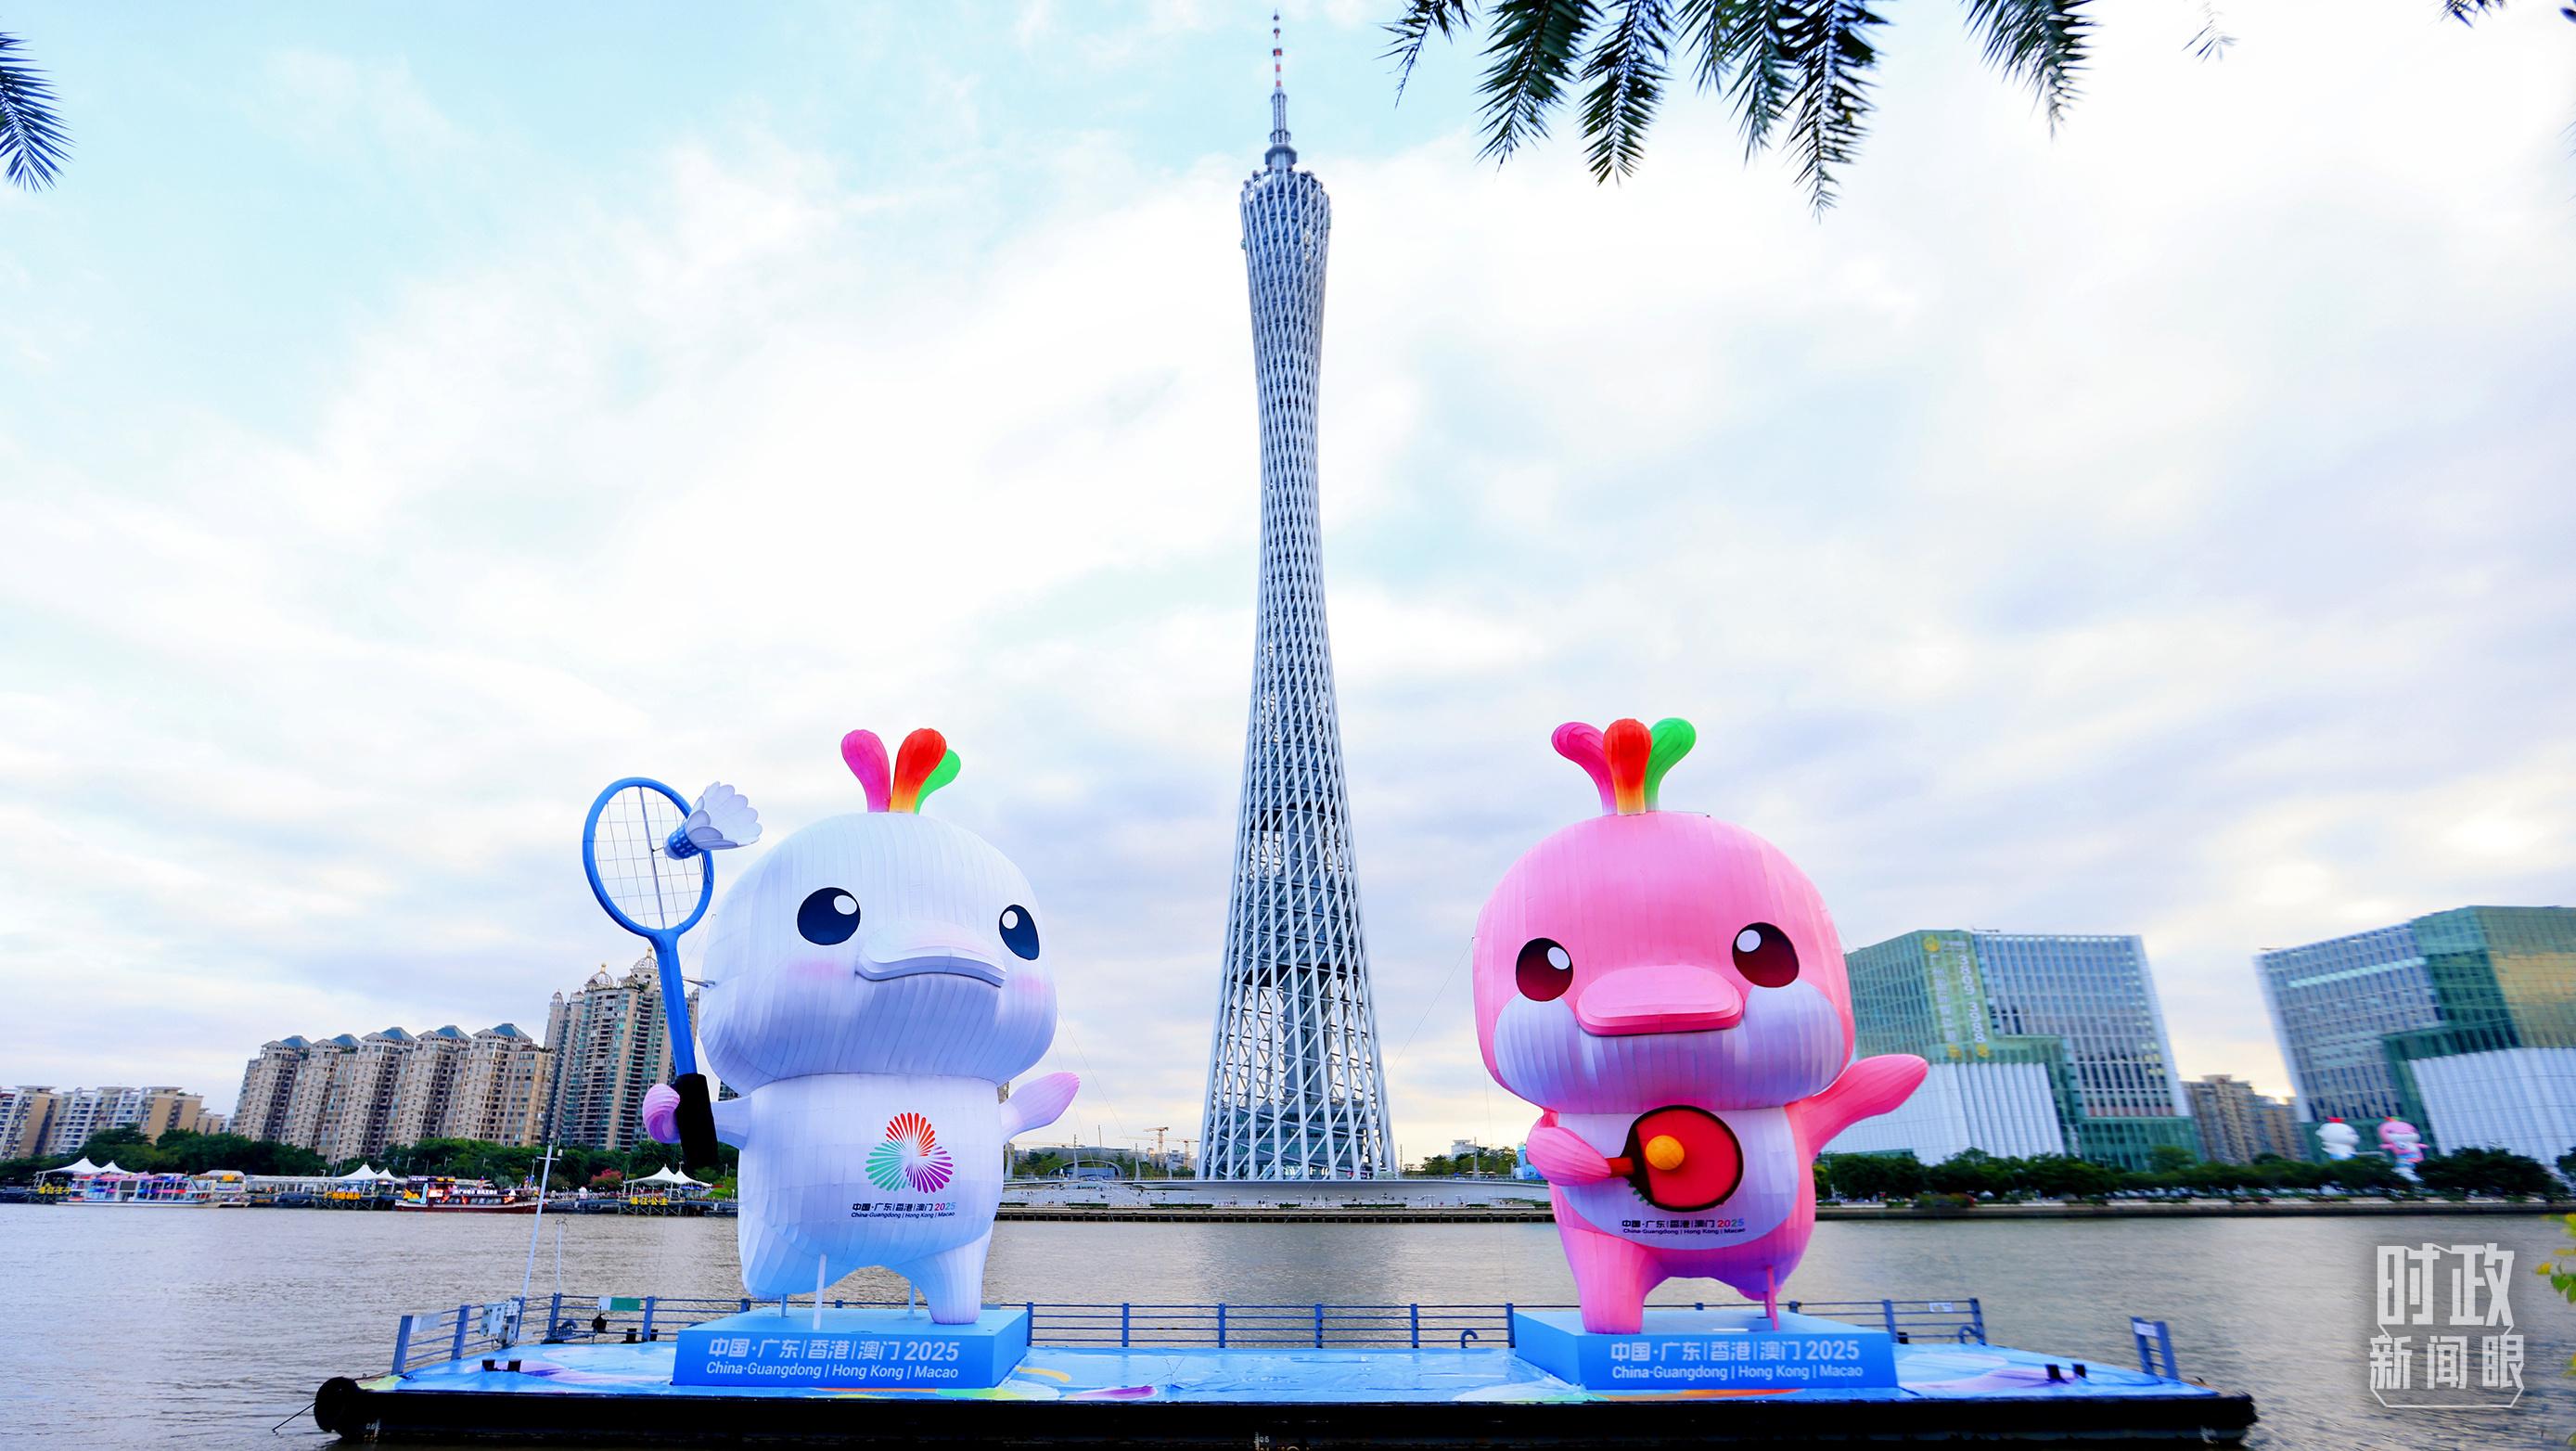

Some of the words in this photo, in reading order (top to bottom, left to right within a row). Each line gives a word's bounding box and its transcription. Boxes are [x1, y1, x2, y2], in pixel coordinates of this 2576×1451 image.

[935, 1202, 956, 1212] 2025
[1717, 1218, 1745, 1227] 2025
[904, 1342, 959, 1362] 2025
[1806, 1340, 1860, 1361] 2025
[832, 1365, 866, 1380] Hong
[870, 1365, 904, 1380] Kong
[915, 1367, 959, 1380] Macao
[1738, 1366, 1773, 1380] Hong
[1776, 1365, 1809, 1380] Kong
[1820, 1365, 1864, 1378] Macao
